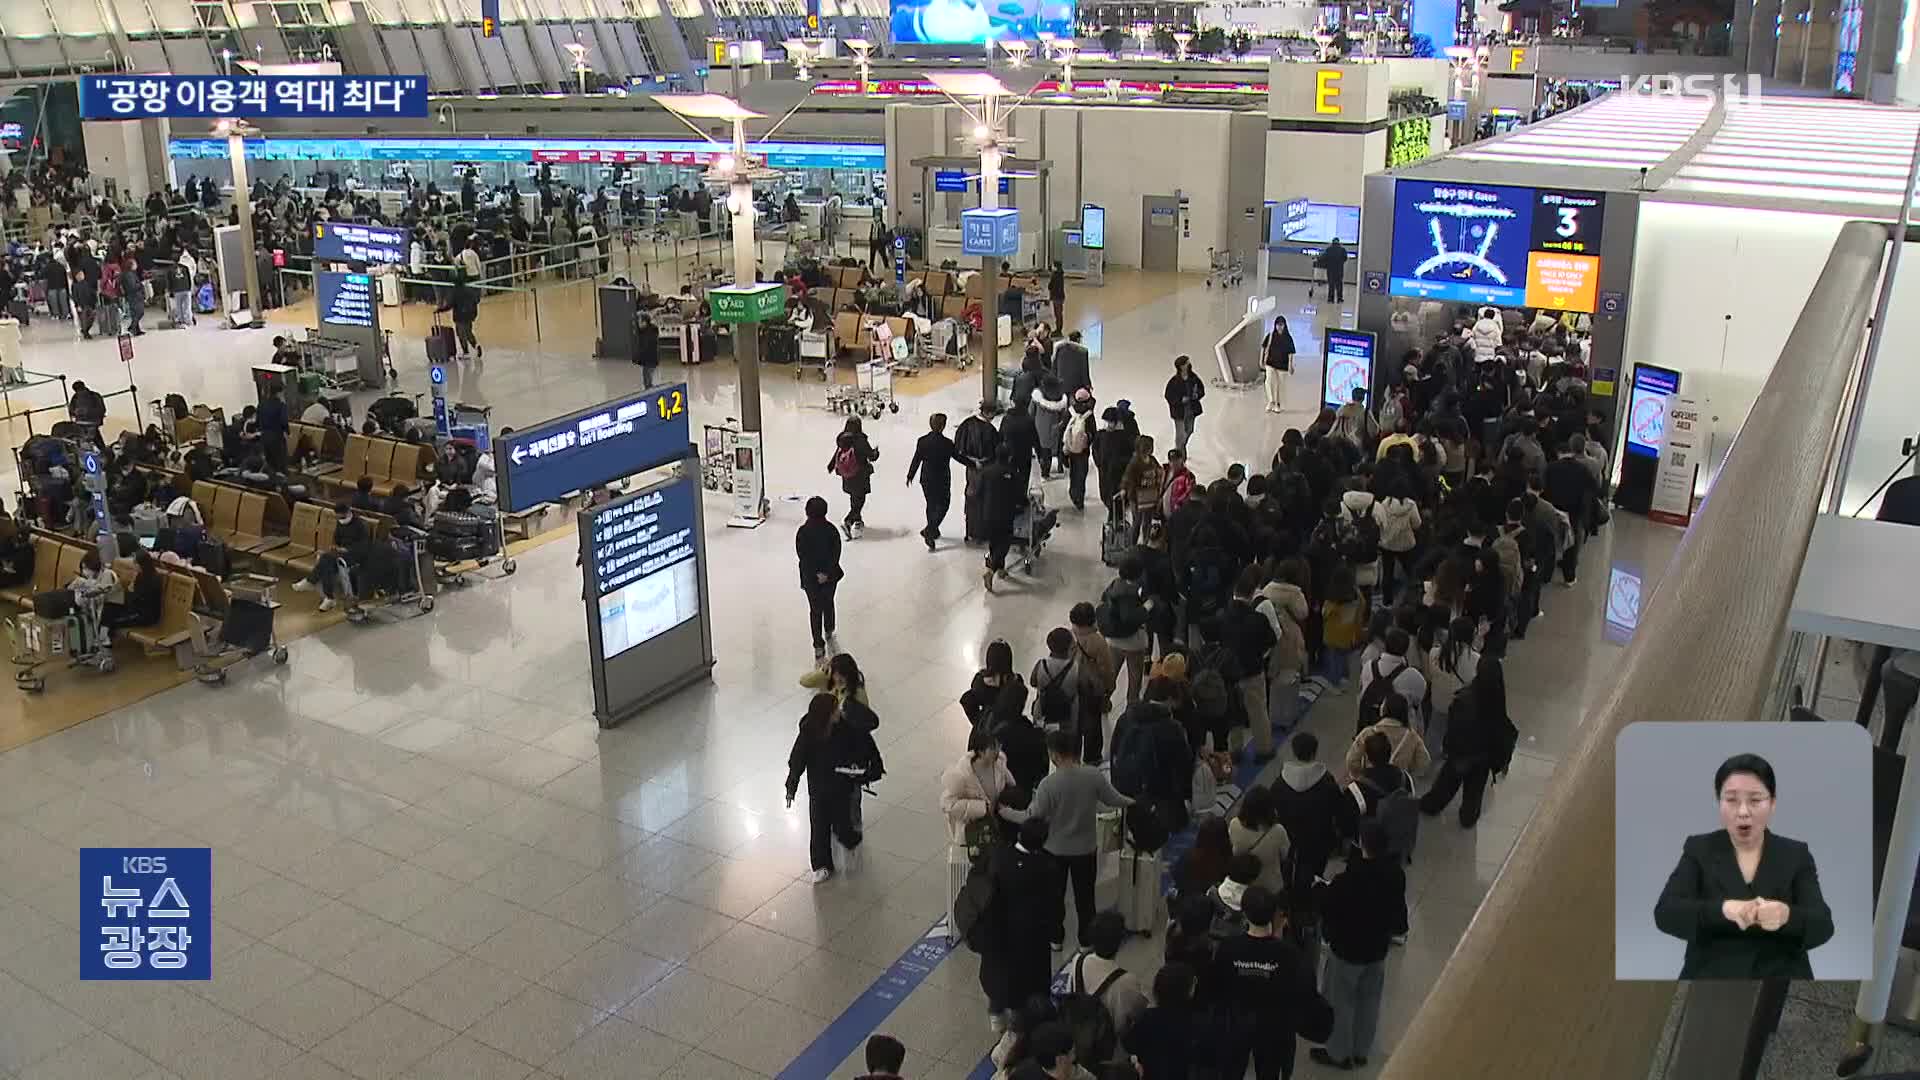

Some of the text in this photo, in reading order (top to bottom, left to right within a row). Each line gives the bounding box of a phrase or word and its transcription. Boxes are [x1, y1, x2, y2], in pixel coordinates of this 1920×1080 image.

[714, 43, 726, 64] F
[1511, 49, 1525, 71] F
[1315, 69, 1343, 115] E
[969, 223, 991, 238] 카트
[1555, 207, 1578, 238] 3
[968, 238, 991, 247] CARTS
[729, 299, 745, 308] AED
[657, 391, 682, 420] 1,2
[597, 421, 633, 441] Boarding
